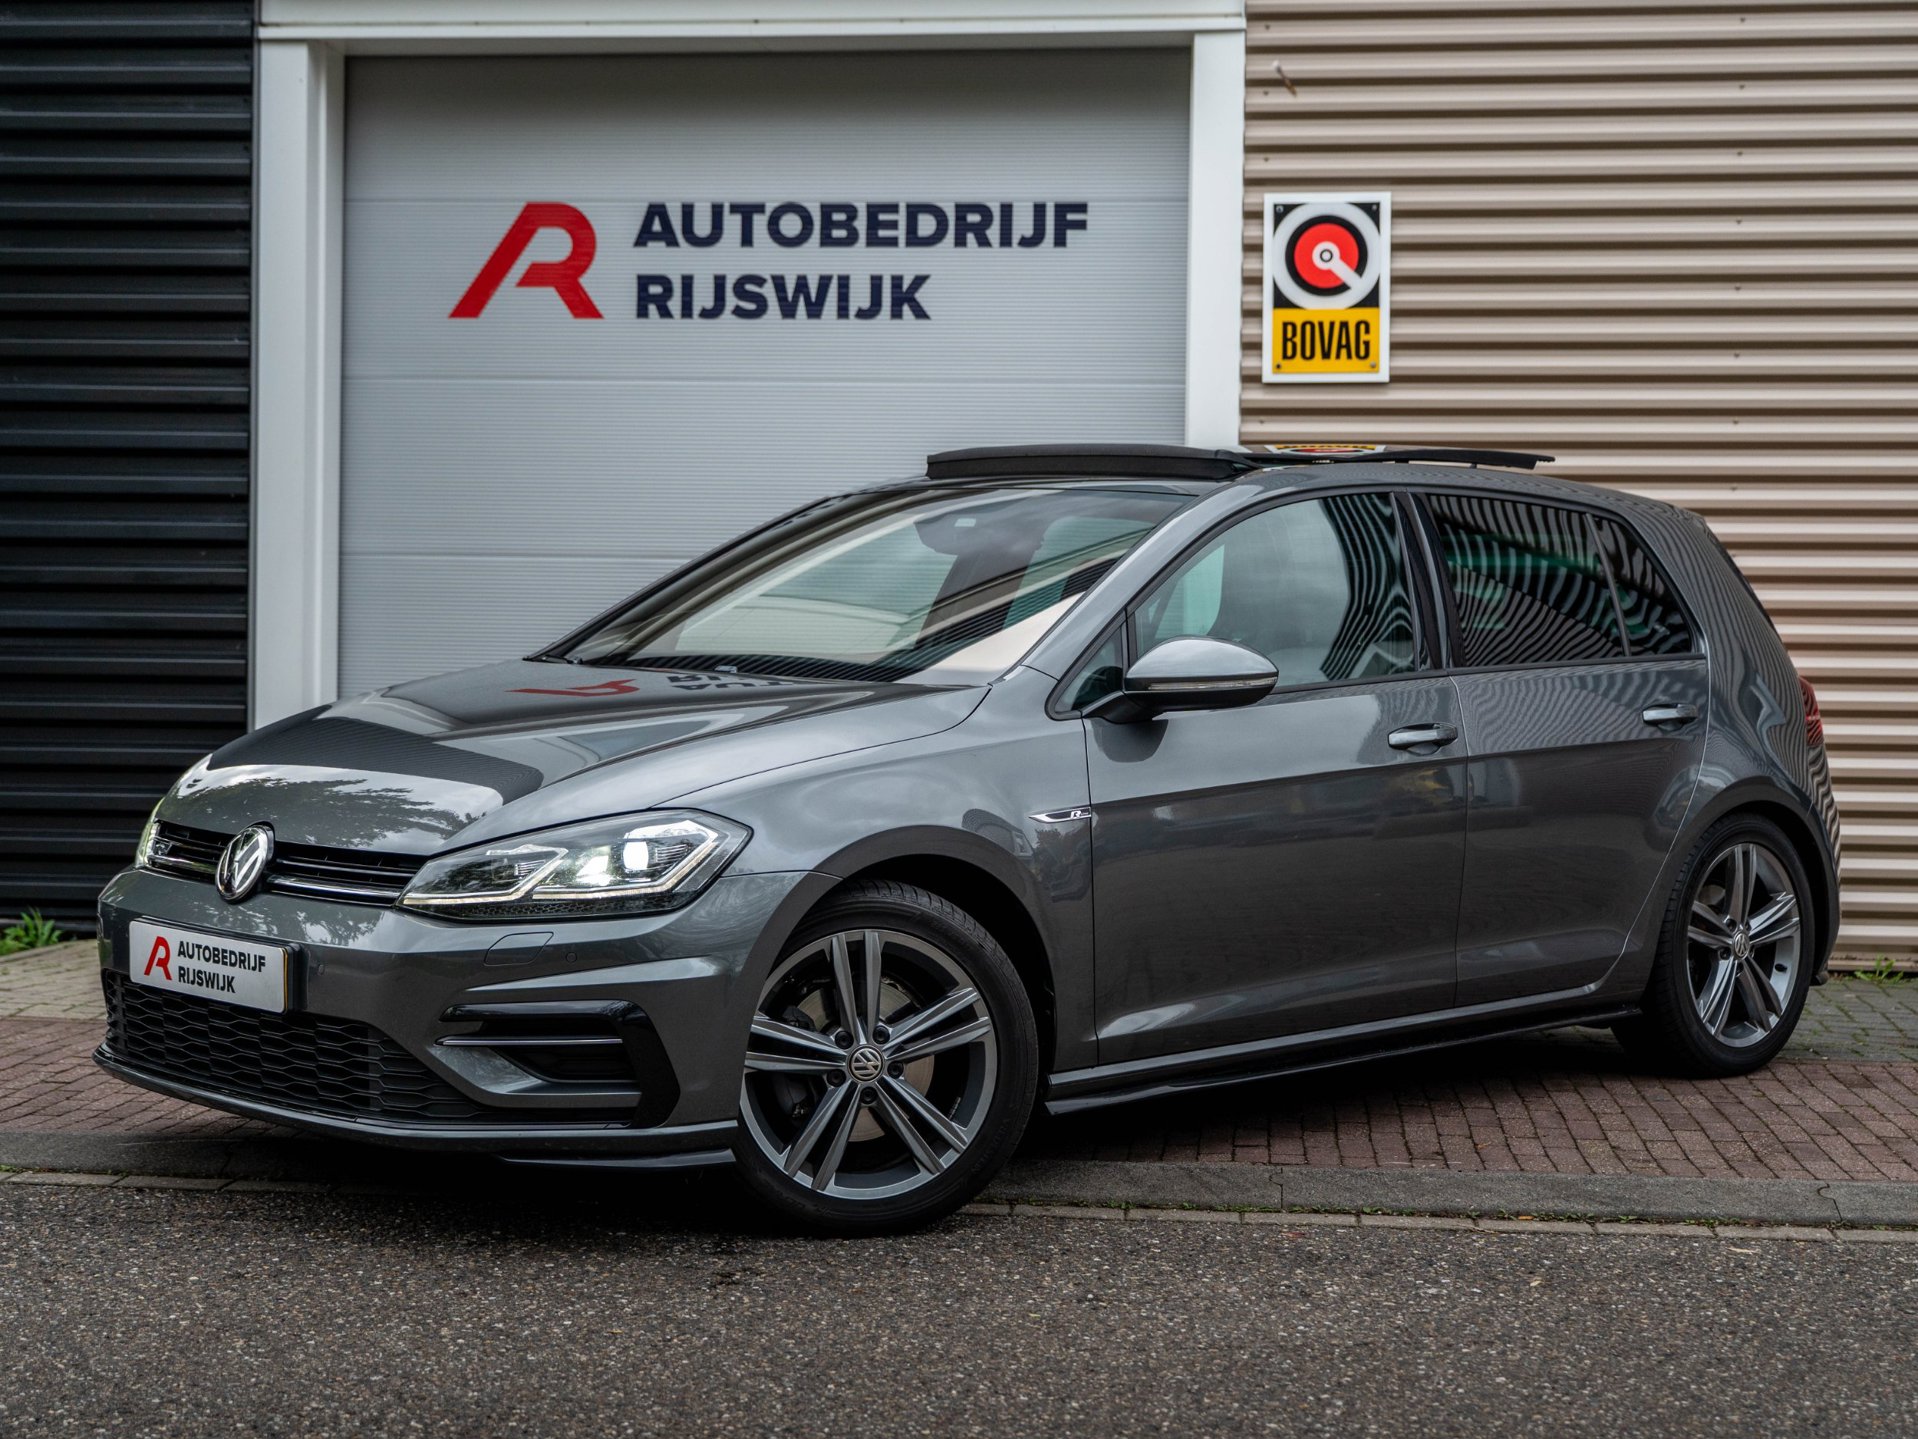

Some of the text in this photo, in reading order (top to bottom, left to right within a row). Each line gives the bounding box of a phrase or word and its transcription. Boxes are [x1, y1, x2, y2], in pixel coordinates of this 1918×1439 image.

[633, 201, 1089, 249] AUTOBEDRIJF
[635, 273, 932, 320] RIJSWIJK
[1281, 320, 1371, 361] BOVAG
[177, 940, 266, 972] AUTOBEDRIJF
[178, 966, 236, 993] RIJSWIJK
